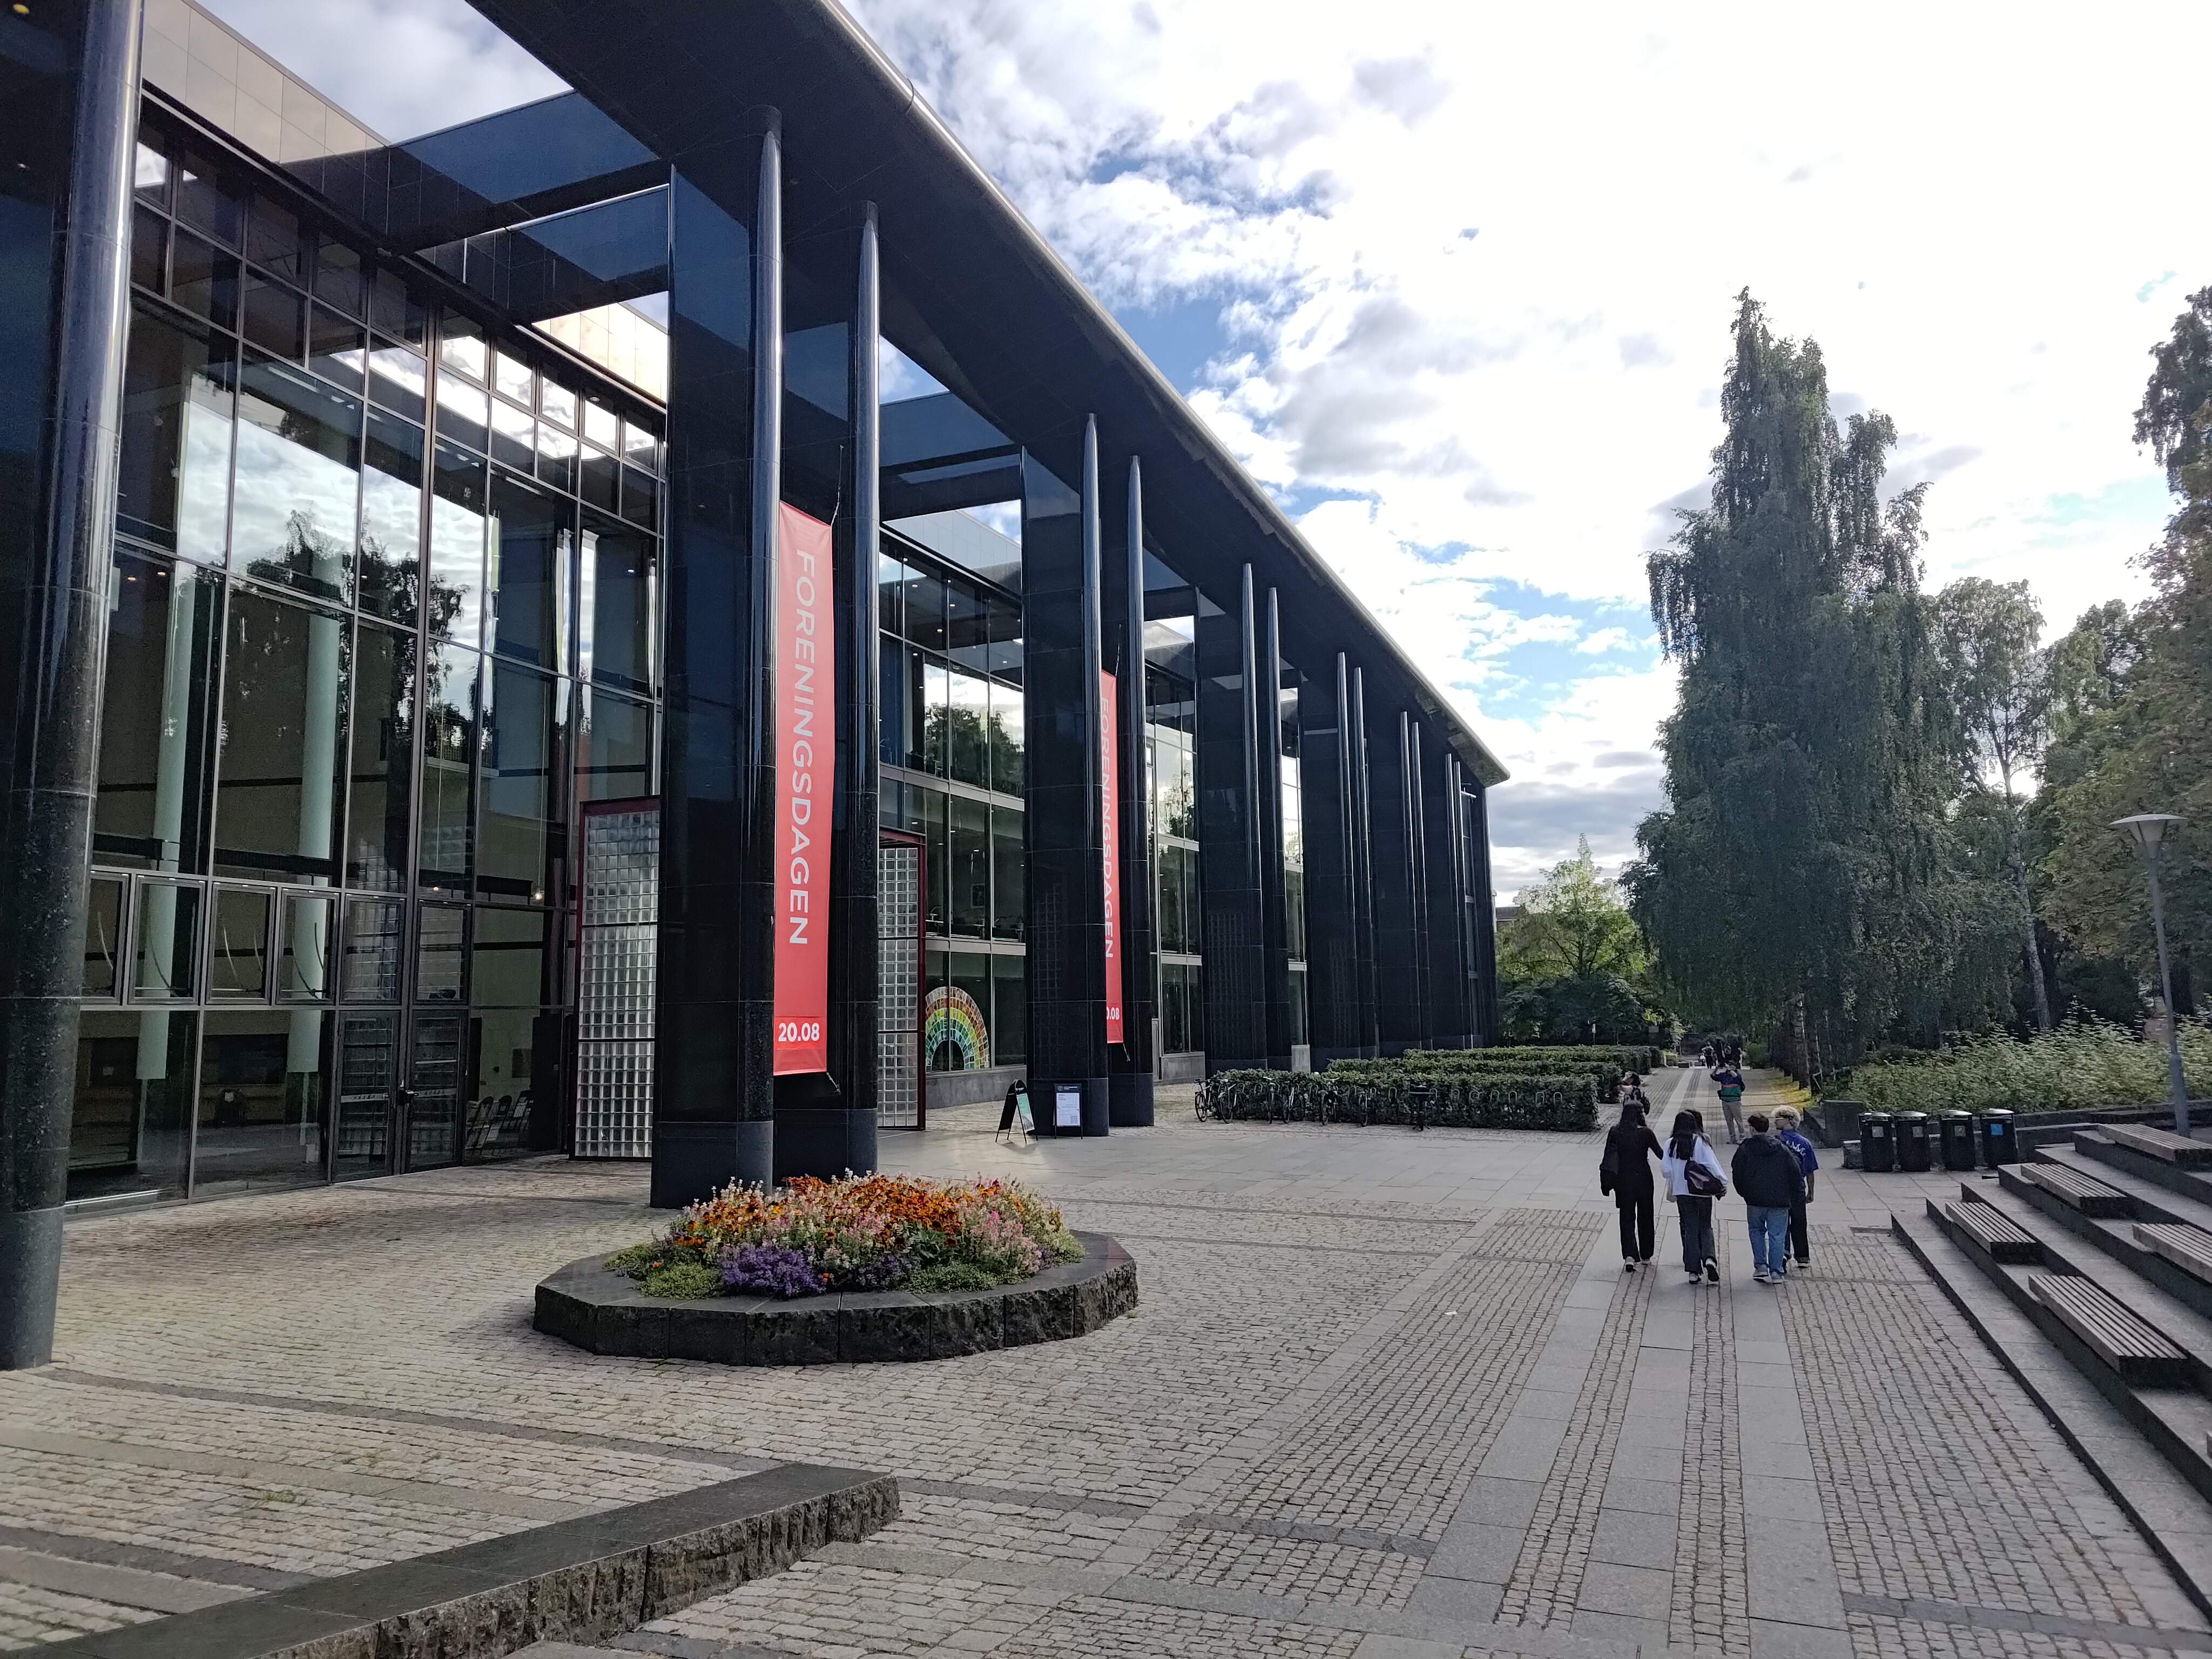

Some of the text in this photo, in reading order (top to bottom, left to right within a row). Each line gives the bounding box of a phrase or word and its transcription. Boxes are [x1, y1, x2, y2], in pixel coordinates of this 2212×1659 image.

[790, 549, 815, 944] FORENINGSDAGEN
[1102, 697, 1114, 957] FORENINGSDAGEN
[778, 1022, 820, 1042] 20.08
[1107, 1007, 1120, 1020] 0.08
